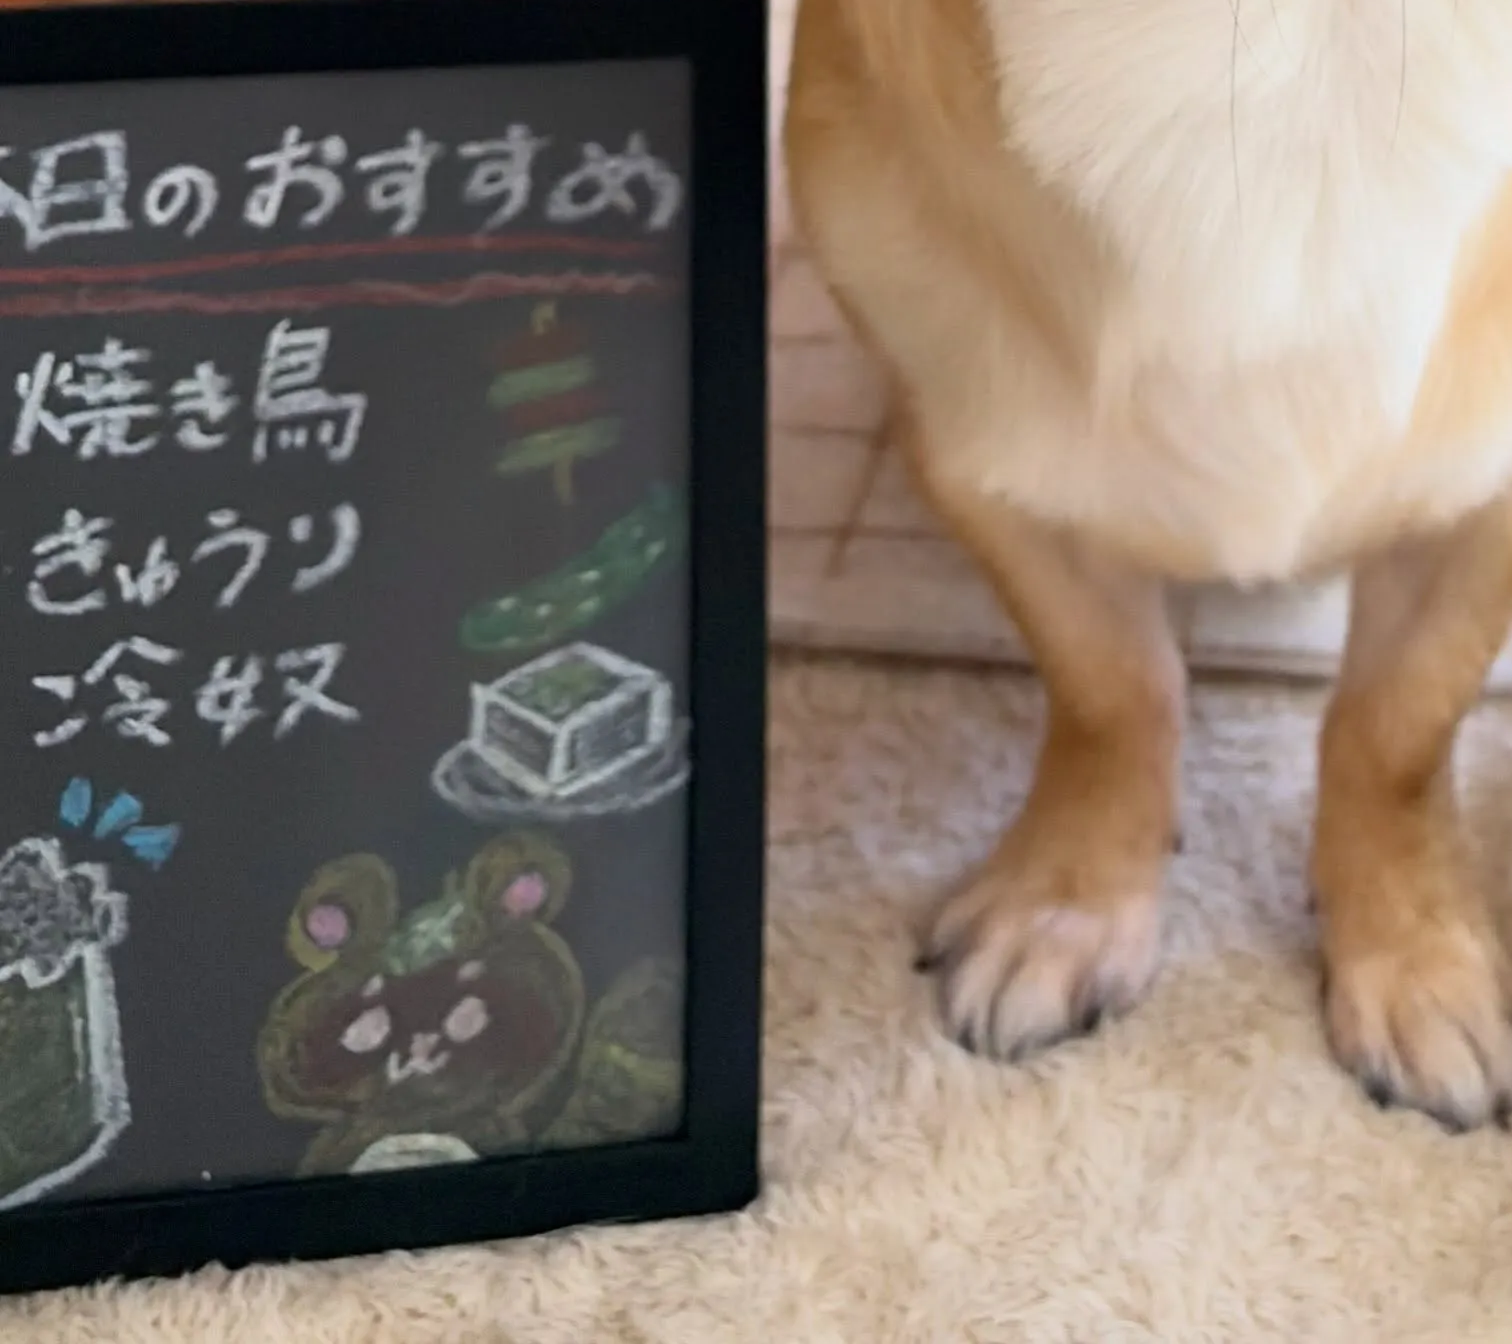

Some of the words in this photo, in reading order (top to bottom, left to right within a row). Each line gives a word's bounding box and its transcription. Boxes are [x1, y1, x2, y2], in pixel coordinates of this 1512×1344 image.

[12, 318, 366, 462] 焼き鳥
[28, 503, 360, 616] きゅうり
[34, 635, 360, 746] 冷奴
